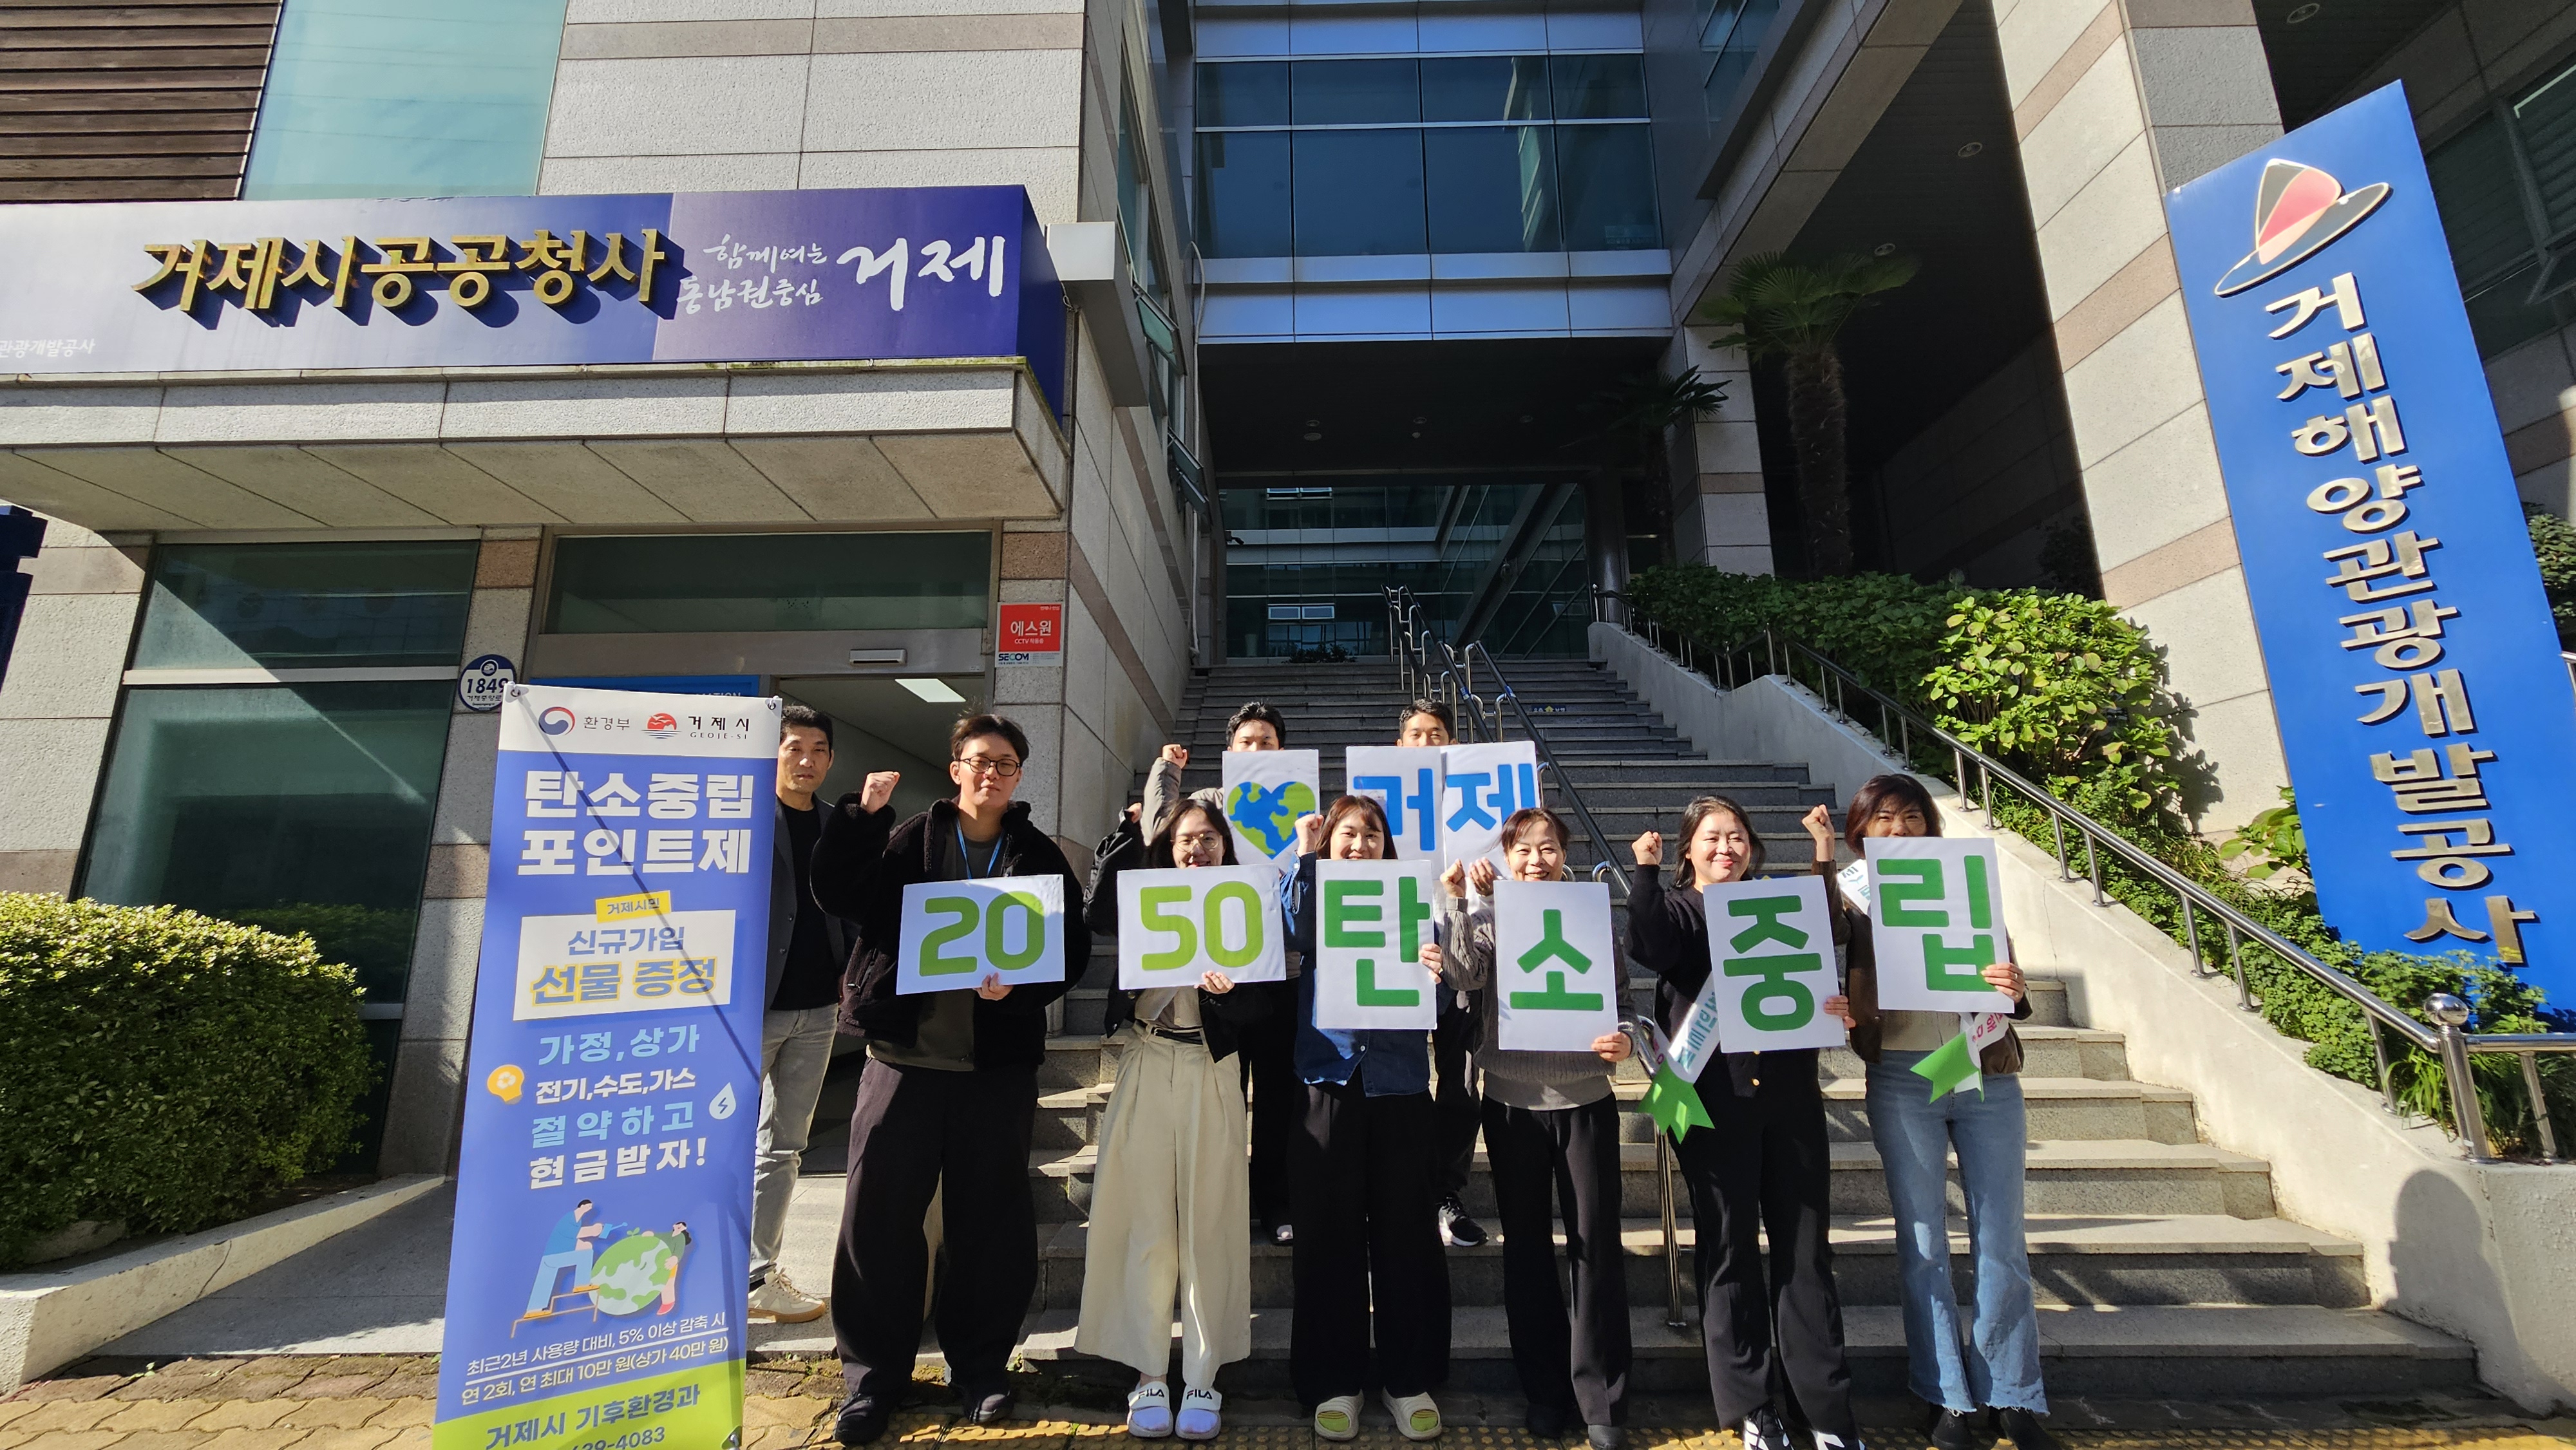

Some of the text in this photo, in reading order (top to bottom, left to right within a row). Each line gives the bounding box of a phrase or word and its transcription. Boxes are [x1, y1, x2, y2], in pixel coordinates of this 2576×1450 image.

[131, 229, 665, 312] 거제시공공청사
[837, 236, 1005, 310] 거제
[1010, 620, 1052, 636] 에스원
[2266, 273, 2535, 963] 거제해양관광개발공사
[998, 653, 1029, 661] SECOM
[583, 716, 630, 731] 환경부
[688, 716, 750, 731] 거제시
[690, 731, 748, 740] GEOJE-SI
[525, 771, 754, 818] 탄소중립
[1354, 763, 1537, 851] 거제
[517, 829, 752, 876] 포인트제
[607, 898, 659, 915] 거제시민
[919, 891, 1046, 977] 20
[1140, 880, 1264, 971] 50
[1876, 855, 1996, 992] 립
[568, 926, 685, 956] 신규가입
[1324, 876, 1430, 1007] 탄
[1509, 909, 1604, 1011] 소
[1723, 895, 1823, 1031] 중
[532, 957, 717, 1006] 선물 증정
[462, 1386, 480, 1406] 연
[482, 1379, 516, 1402] 2회,
[520, 1374, 537, 1393] 연
[540, 1367, 574, 1388] 최대
[577, 1359, 612, 1381] 10만
[668, 1341, 706, 1362] 40만
[709, 1336, 729, 1354] 원)
[466, 1312, 726, 1376] 최근2년 사용량 대비, 5% 이상 감축 시
[485, 1383, 701, 1450] 거제시 기후환경과
[1138, 1388, 1164, 1400] FILA
[1186, 1389, 1213, 1400] FILA
